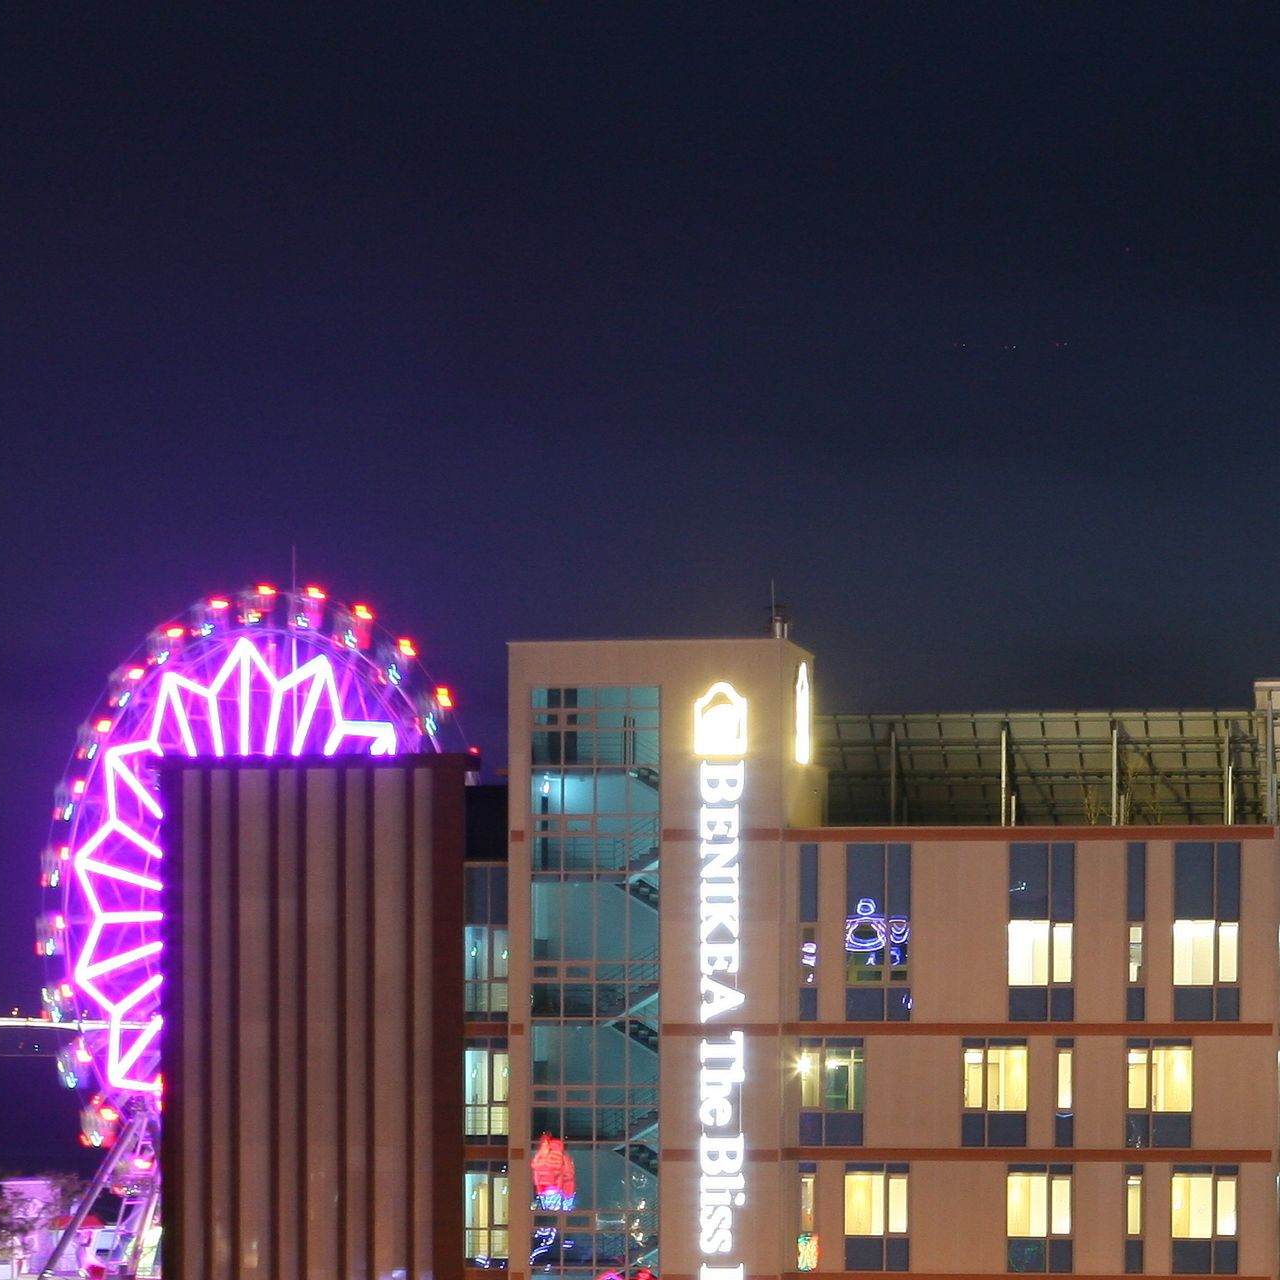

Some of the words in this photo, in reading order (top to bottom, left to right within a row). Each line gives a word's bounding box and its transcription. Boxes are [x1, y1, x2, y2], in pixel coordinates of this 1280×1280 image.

[700, 760, 746, 1024] BENIKEA
[700, 1031, 746, 1127] The
[699, 1132, 746, 1254] Bliss
